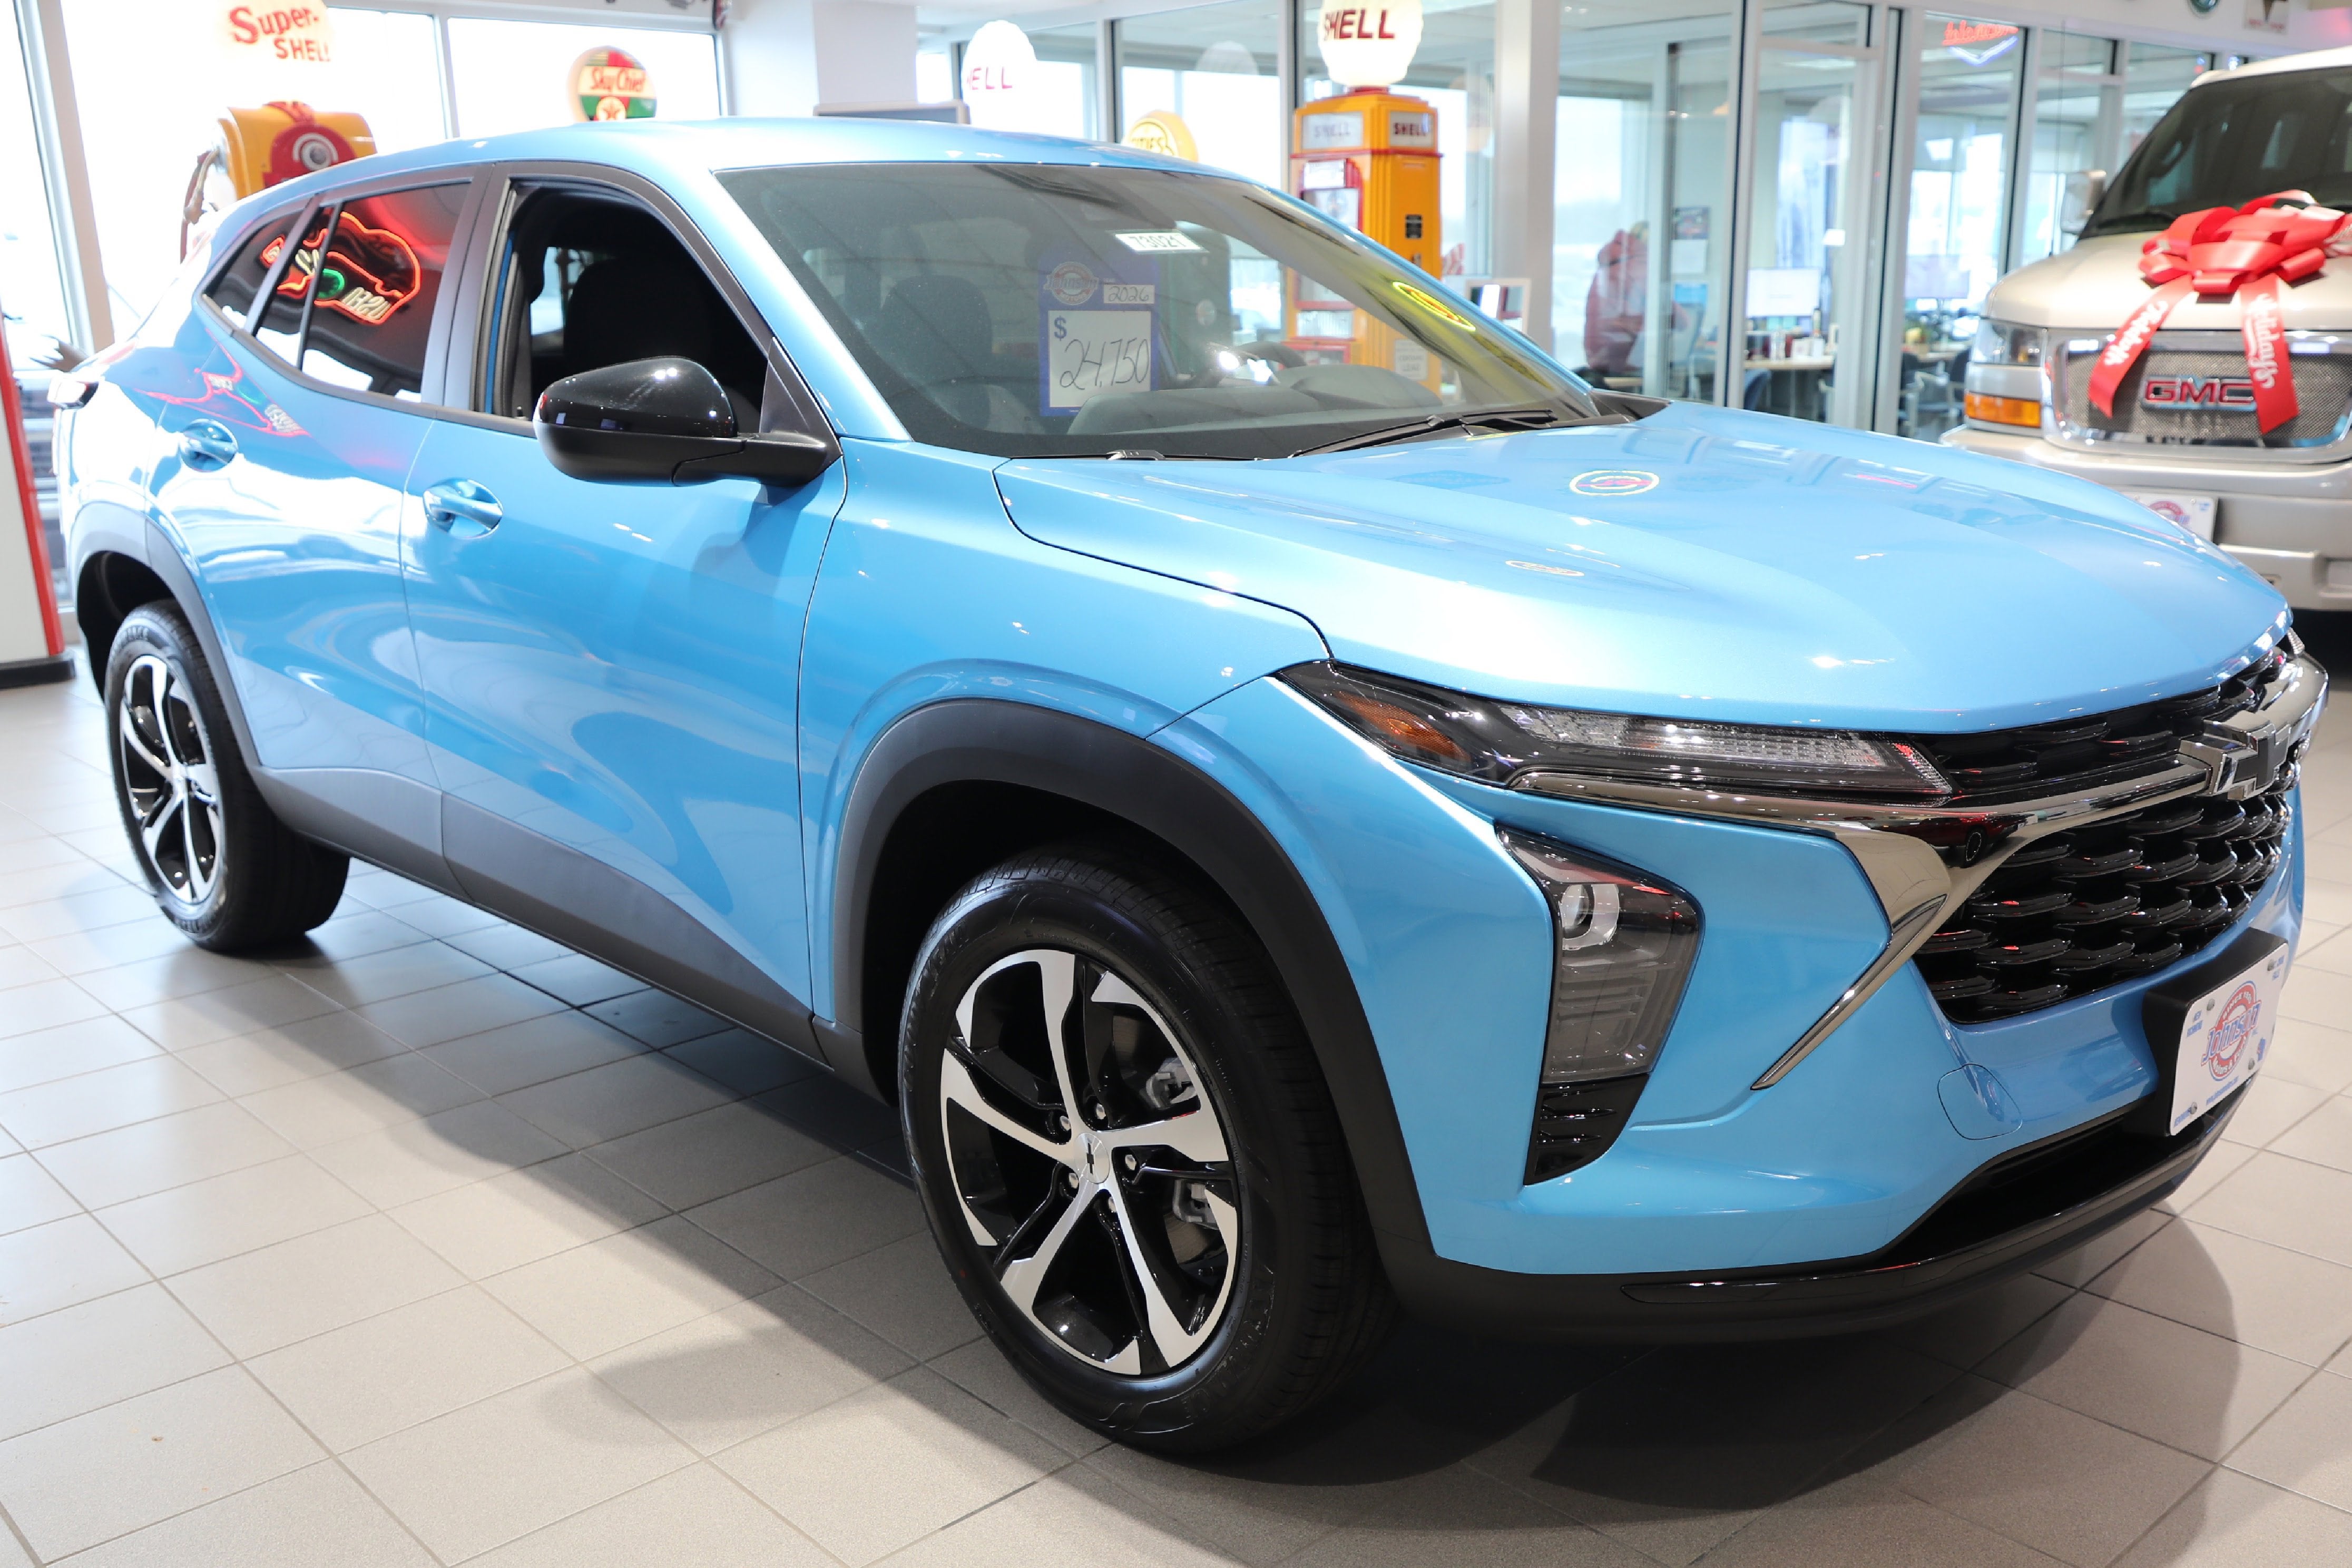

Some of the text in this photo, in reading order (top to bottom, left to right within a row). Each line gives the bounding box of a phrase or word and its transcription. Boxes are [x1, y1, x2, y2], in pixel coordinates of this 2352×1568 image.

[967, 67, 1013, 90] ELL
[1108, 286, 1150, 302] 2026
[1054, 316, 1067, 341] $
[1060, 338, 1150, 390] 24,750
[2142, 377, 2254, 405] GMC
[2201, 999, 2262, 1066] Johnson
